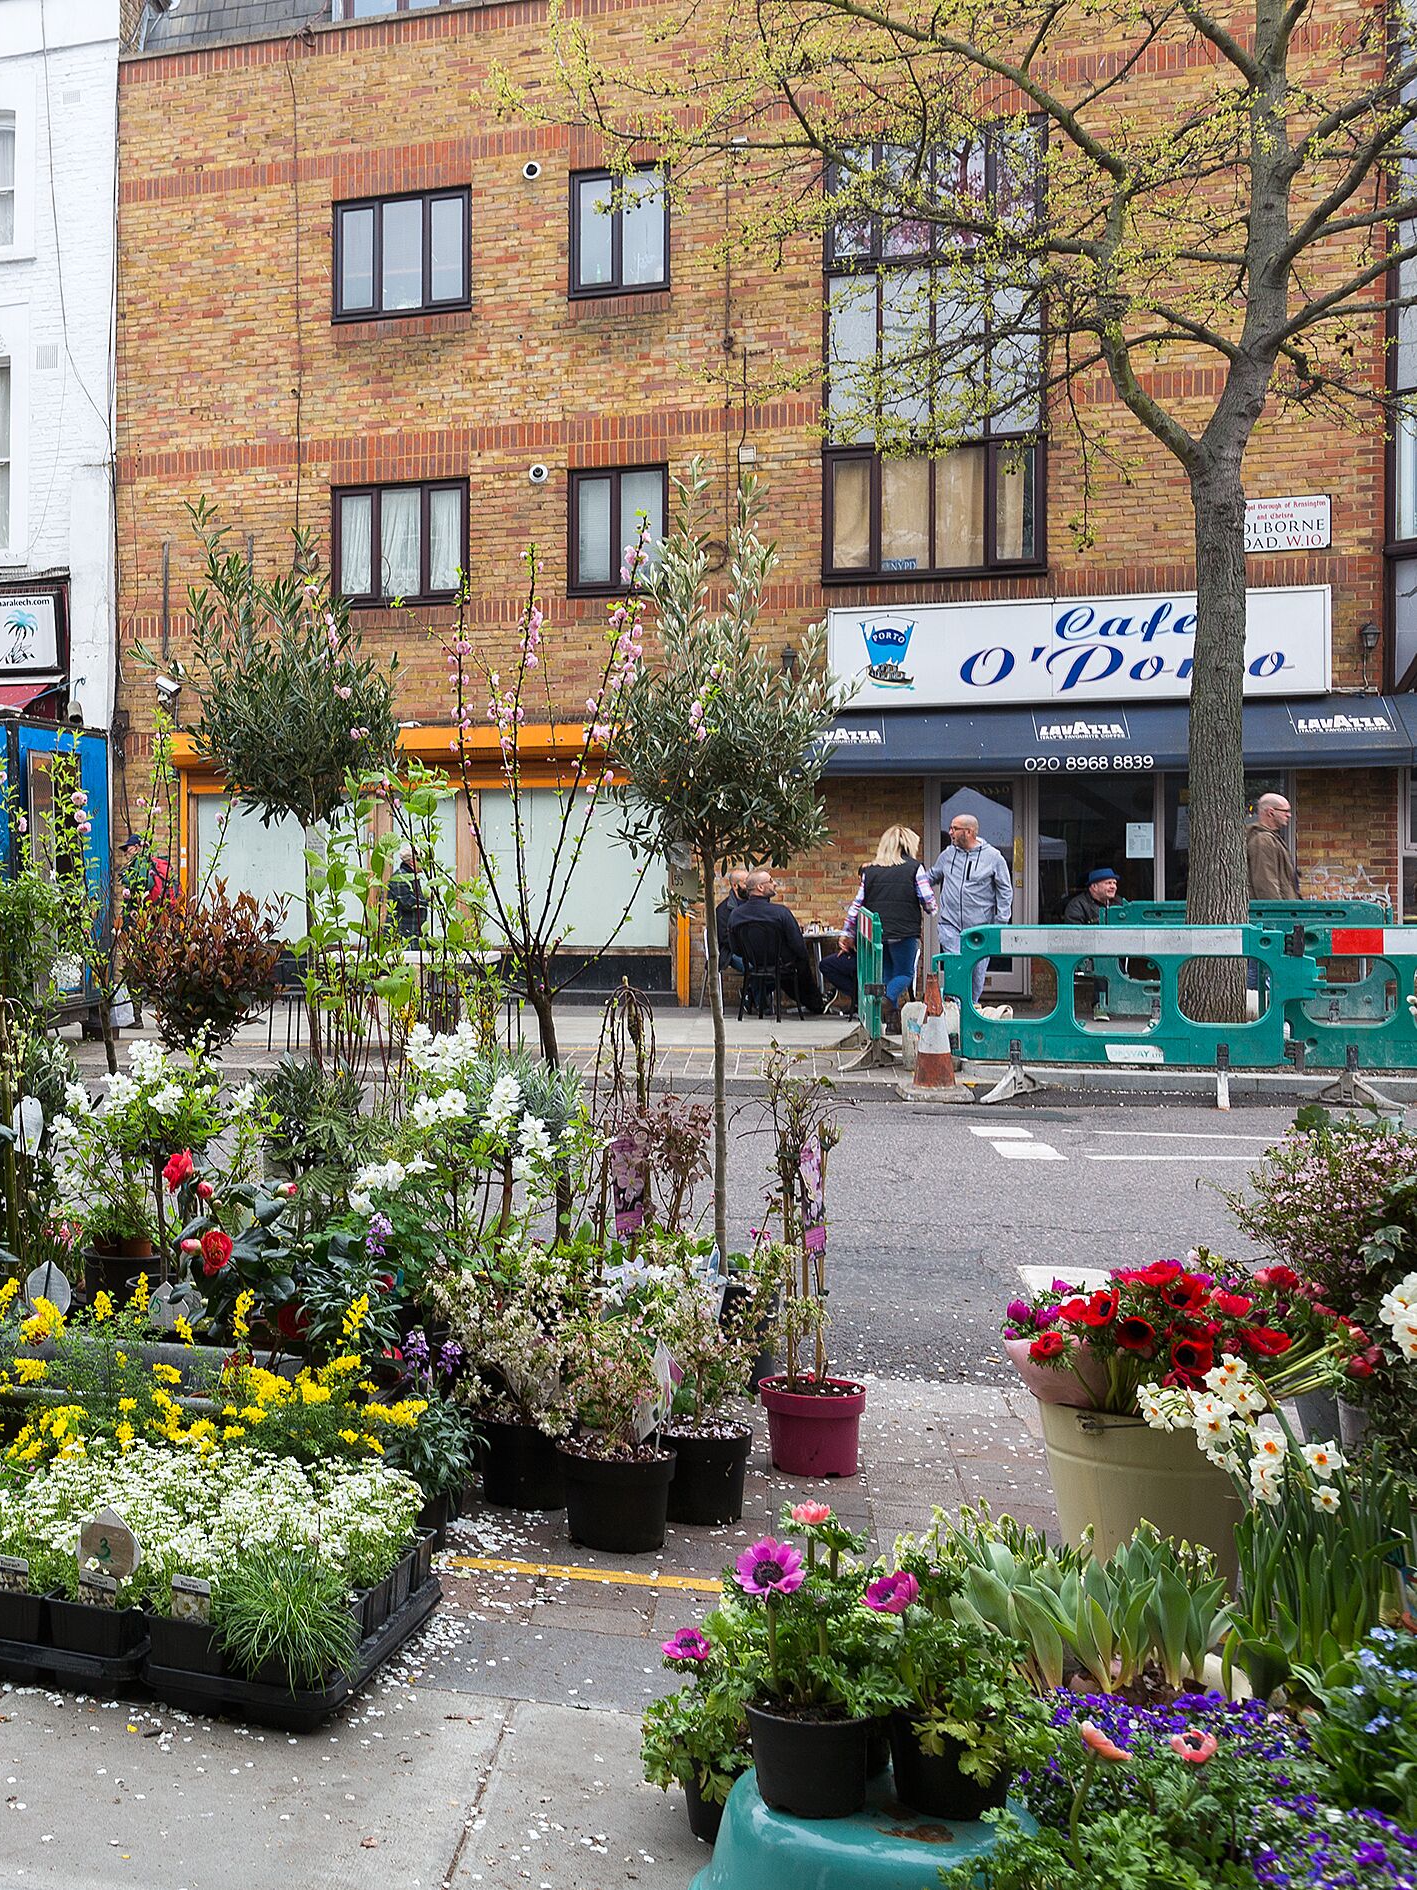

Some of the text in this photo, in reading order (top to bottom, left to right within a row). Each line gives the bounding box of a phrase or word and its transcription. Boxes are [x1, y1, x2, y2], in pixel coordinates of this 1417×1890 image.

[1257, 502, 1282, 511] Borough
[1293, 500, 1326, 508] Kensington
[1269, 512, 1294, 520] Chelsea
[1244, 519, 1325, 535] OLBORNE
[1244, 536, 1281, 550] OAD.
[872, 631, 906, 644] PORTO
[959, 643, 1295, 692] O'Poro
[1039, 720, 1125, 736] LAVAZZA
[1297, 714, 1390, 730] LAVAZZA
[819, 728, 882, 740] VAZZA
[1024, 755, 1154, 771] 020 8968 8839
